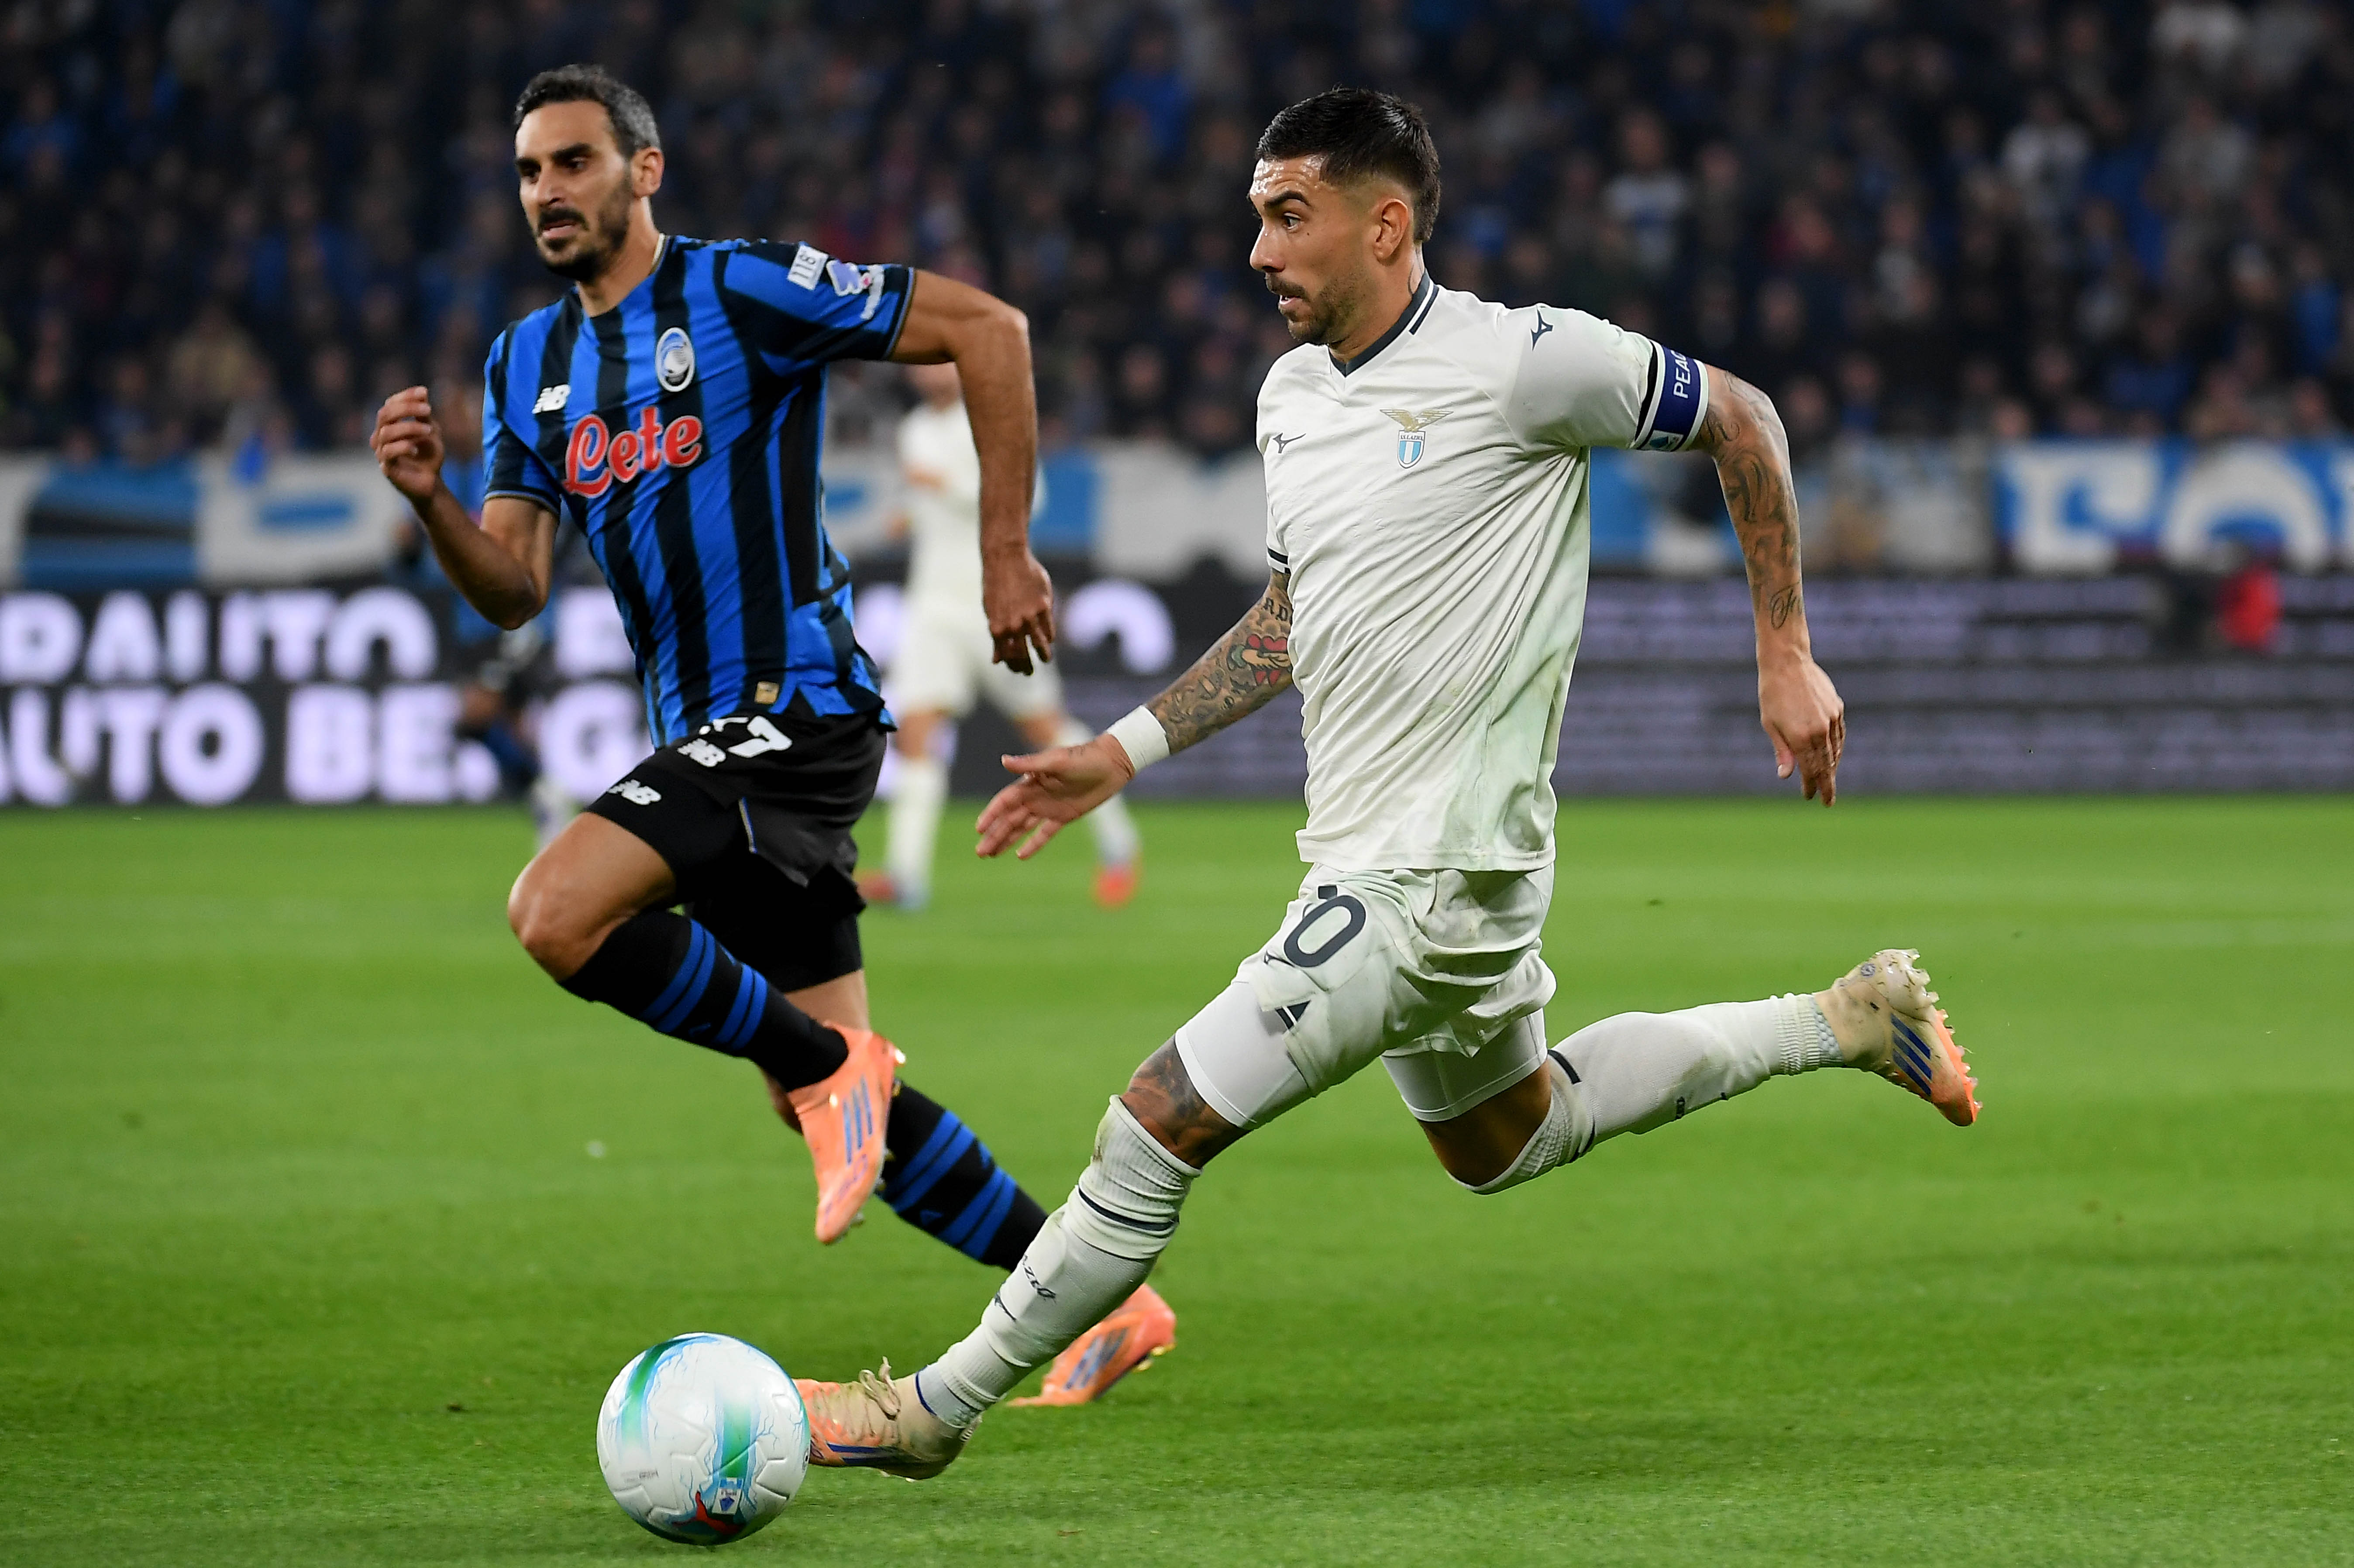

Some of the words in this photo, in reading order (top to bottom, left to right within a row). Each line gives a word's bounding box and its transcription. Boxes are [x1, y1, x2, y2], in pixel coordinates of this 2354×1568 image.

[562, 406, 703, 499] Lete
[0, 682, 262, 807] UTO
[1284, 885, 1366, 968] 0
